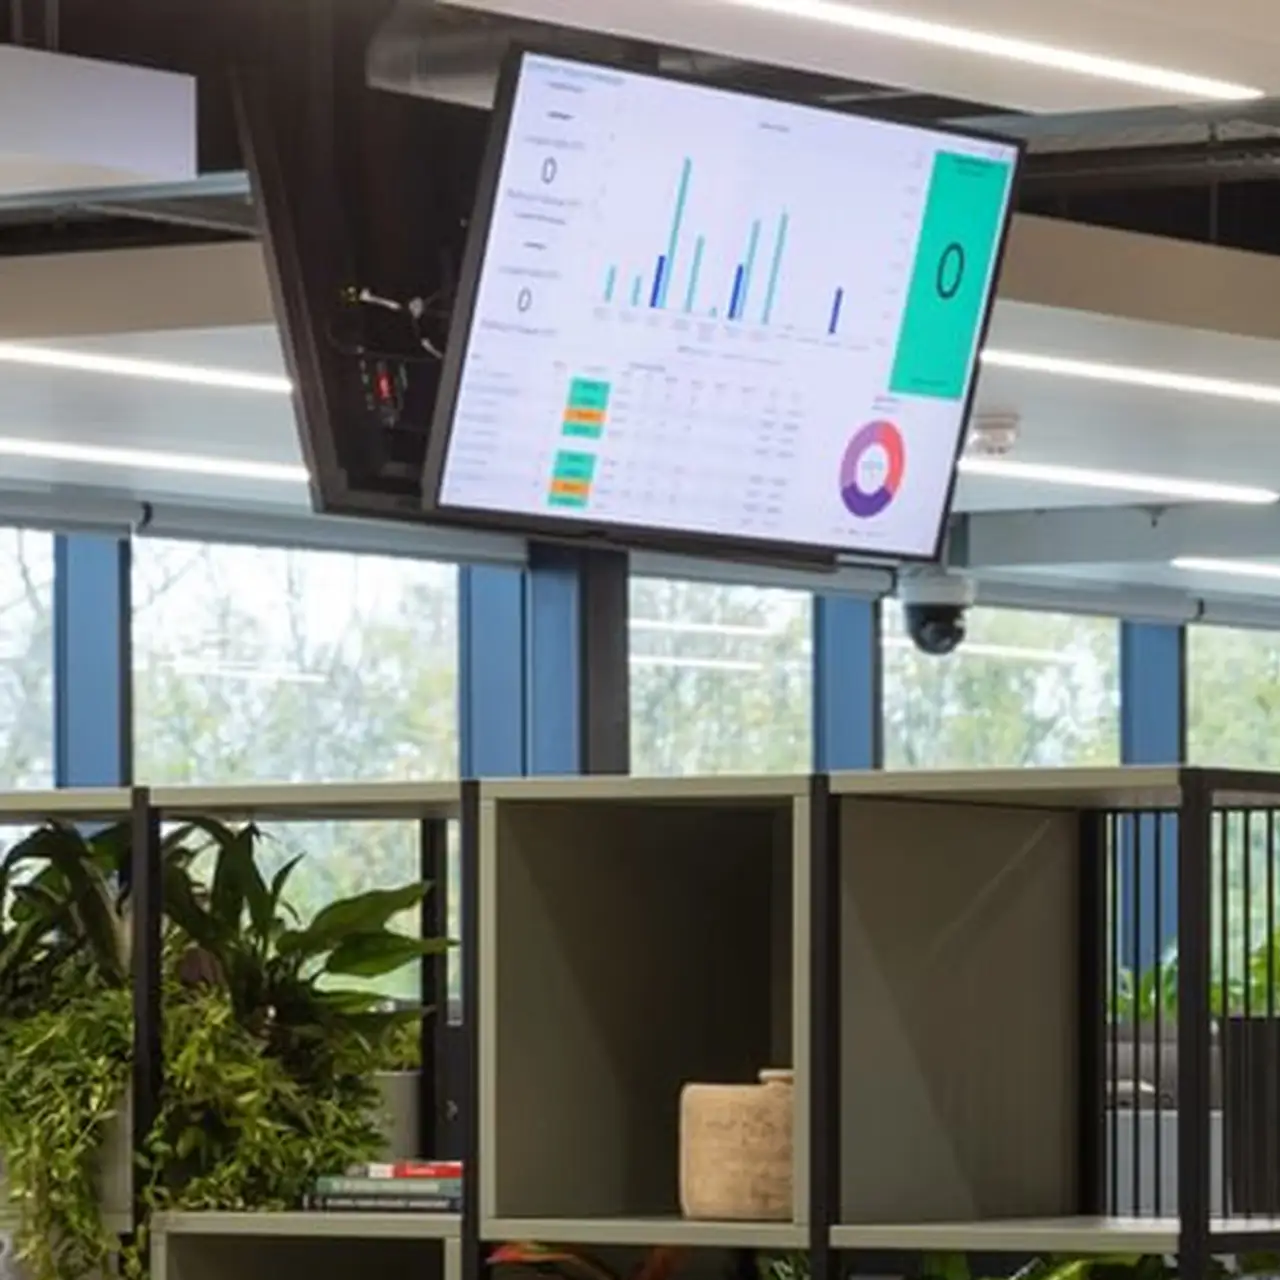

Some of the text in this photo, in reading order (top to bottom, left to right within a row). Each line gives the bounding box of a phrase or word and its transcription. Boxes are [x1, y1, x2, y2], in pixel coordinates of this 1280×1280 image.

[541, 156, 557, 184] 0
[936, 242, 965, 299] 0
[517, 287, 532, 312] 0
